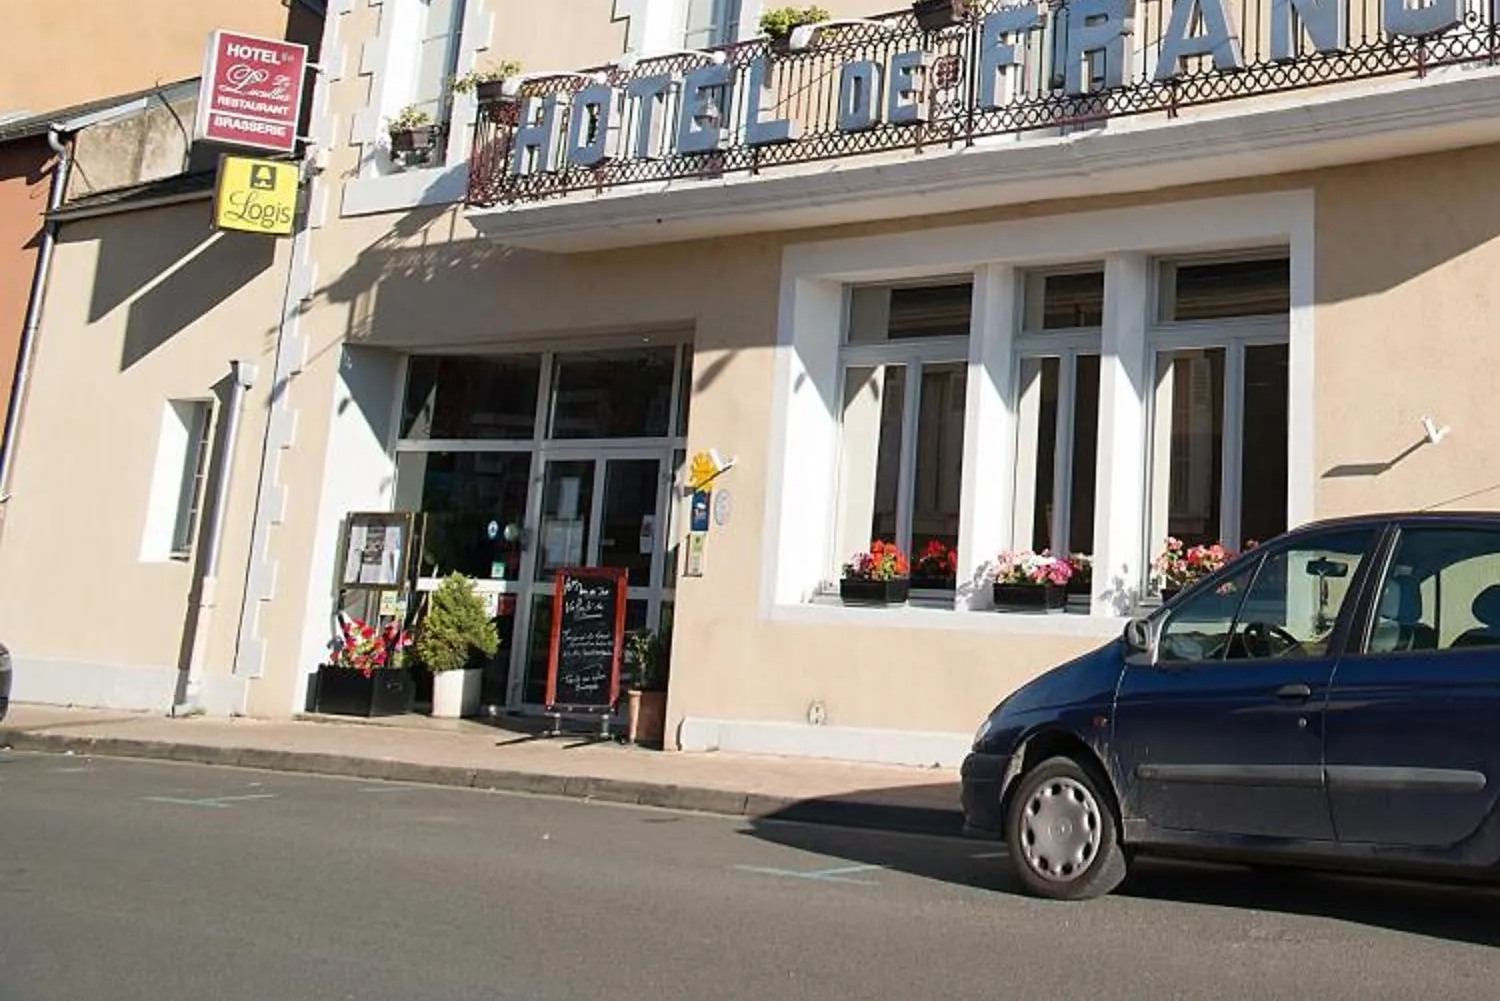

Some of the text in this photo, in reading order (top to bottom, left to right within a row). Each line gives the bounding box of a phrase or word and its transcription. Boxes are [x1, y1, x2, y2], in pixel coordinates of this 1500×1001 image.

[226, 42, 281, 65] HOTEL
[217, 95, 289, 116] RESTAURANT
[512, 55, 799, 177] HOTEL
[839, 49, 931, 132] DE
[213, 115, 287, 137] BRASSERIE
[224, 190, 291, 229] Logis
